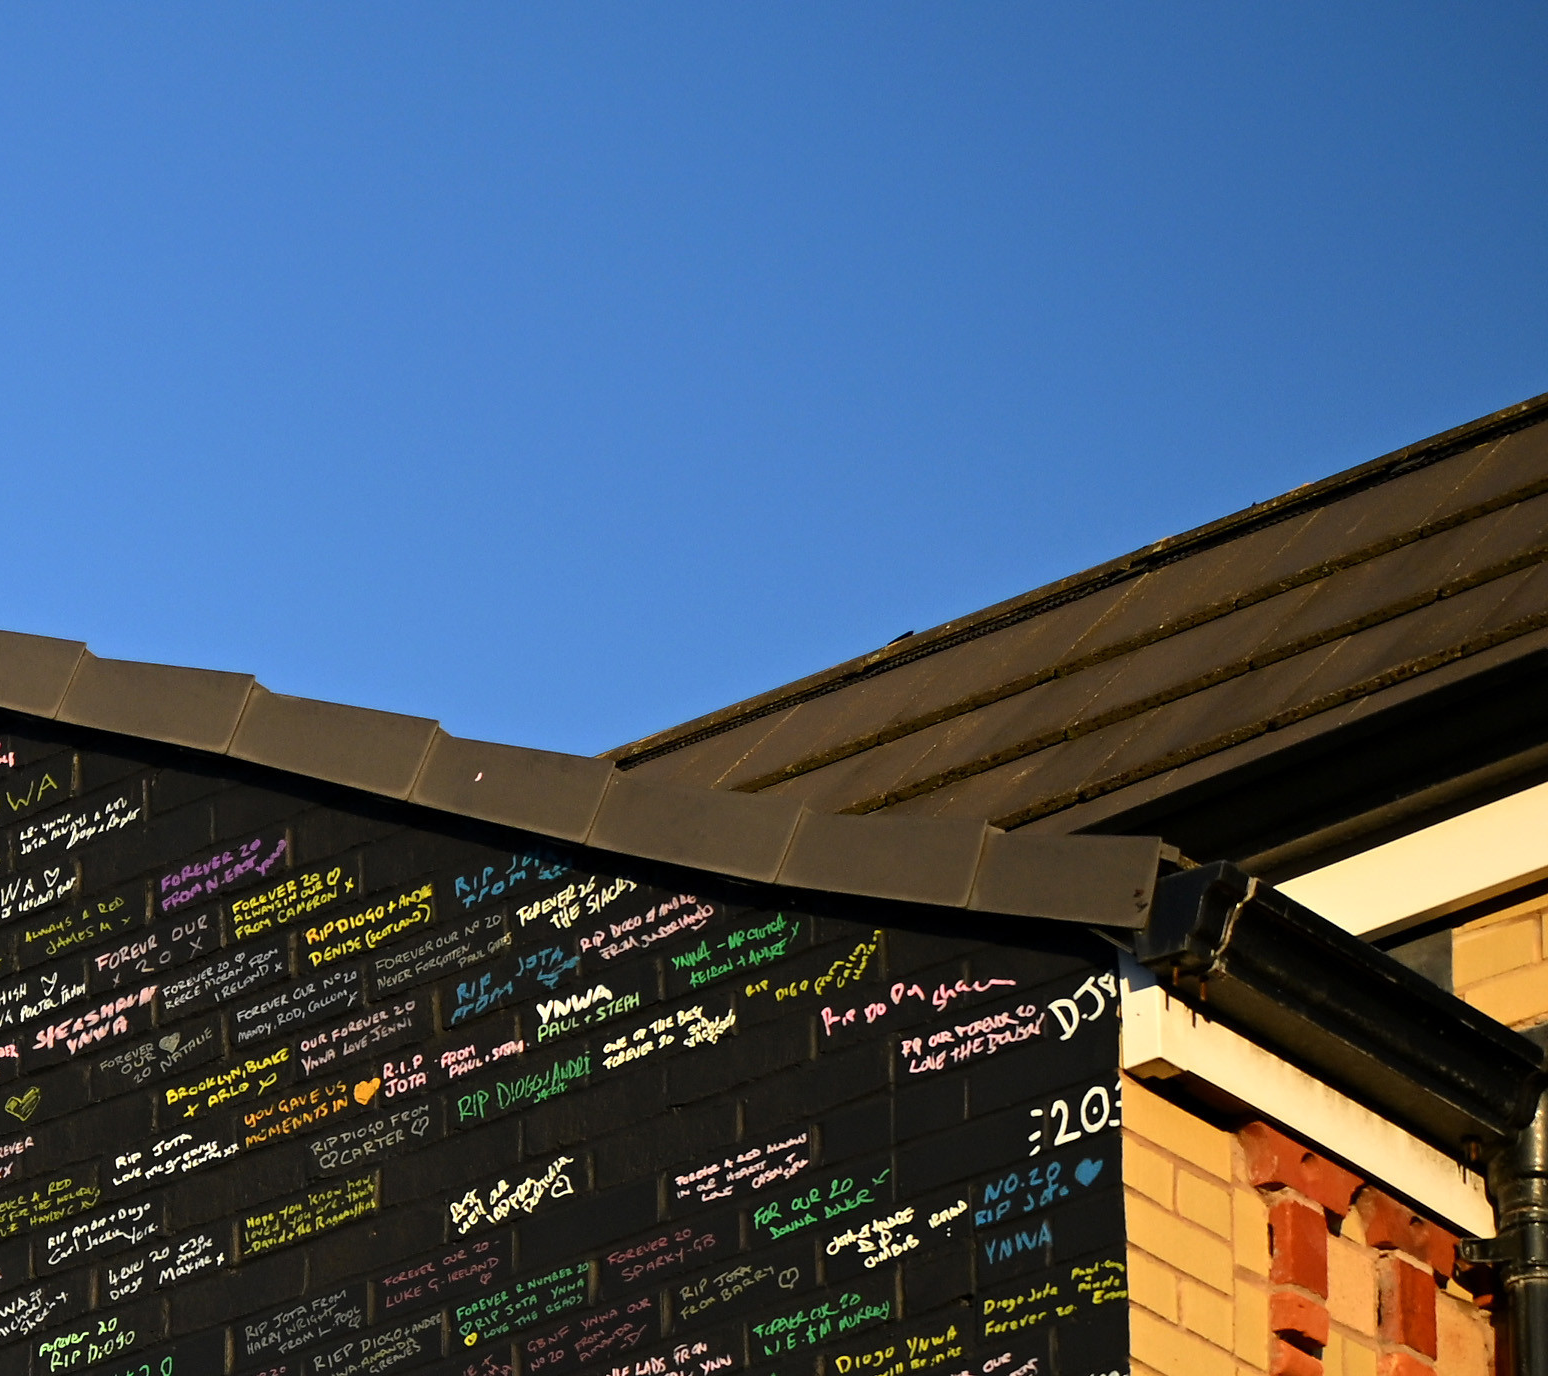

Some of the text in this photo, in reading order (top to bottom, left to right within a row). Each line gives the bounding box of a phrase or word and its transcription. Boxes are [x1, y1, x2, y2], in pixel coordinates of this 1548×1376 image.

[537, 985, 613, 1022] YNWA
[537, 993, 640, 1039] PAUL STEPH
[986, 1222, 1052, 1264] YNWA
